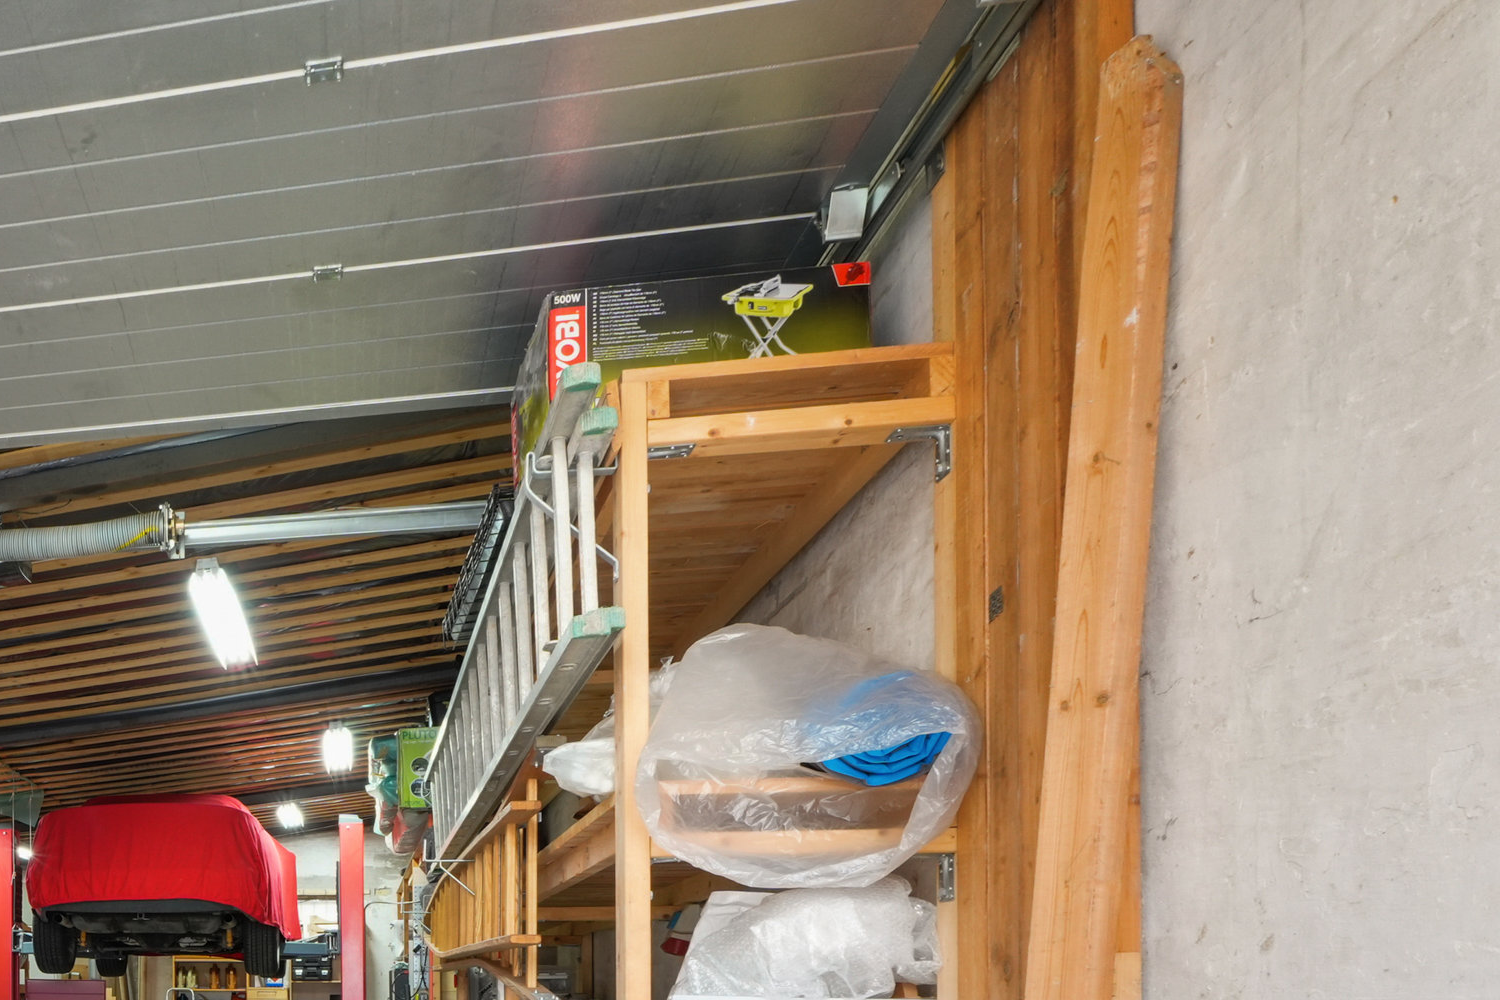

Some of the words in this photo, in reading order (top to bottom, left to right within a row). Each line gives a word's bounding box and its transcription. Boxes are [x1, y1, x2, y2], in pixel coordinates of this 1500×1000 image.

[554, 293, 581, 305] 500W
[555, 313, 580, 384] YOBI
[403, 730, 437, 739] PLUTO
